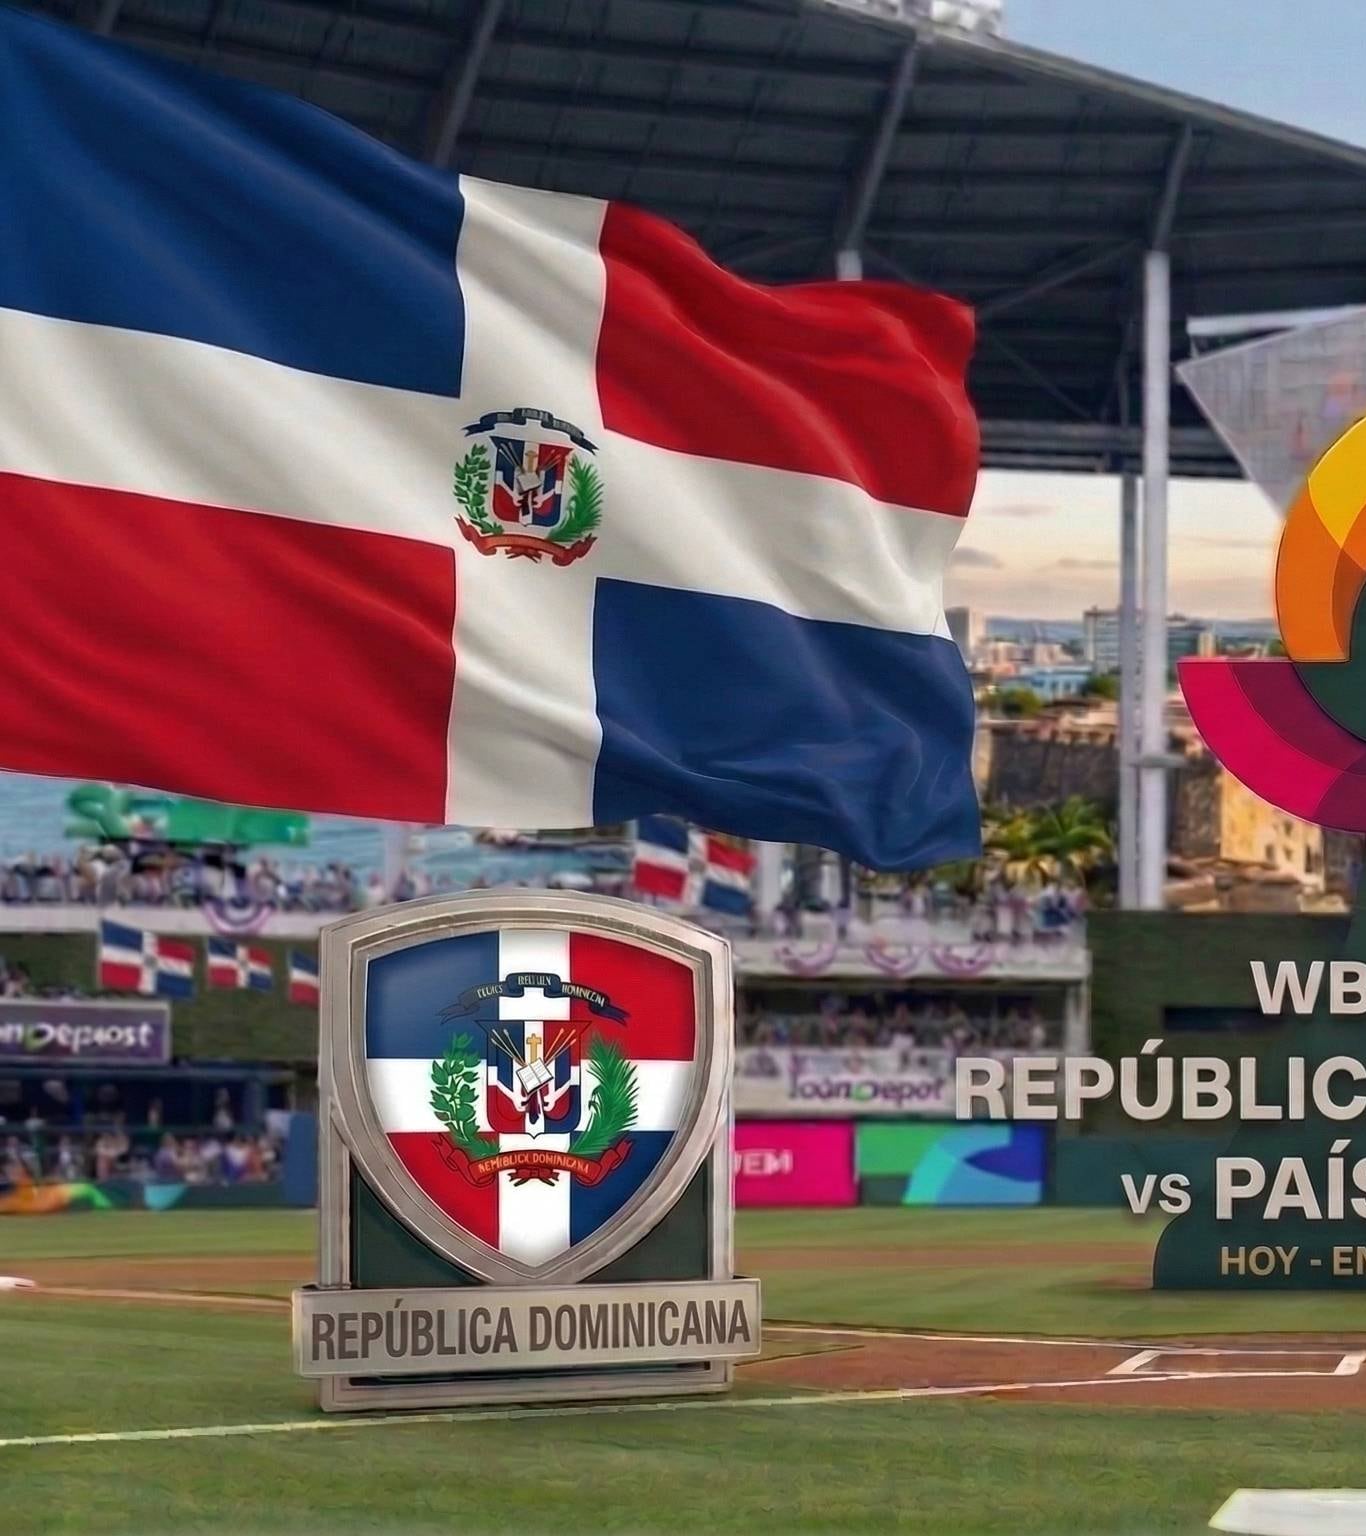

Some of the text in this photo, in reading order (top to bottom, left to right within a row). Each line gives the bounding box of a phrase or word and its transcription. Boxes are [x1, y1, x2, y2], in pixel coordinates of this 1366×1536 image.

[1221, 1246, 1299, 1275] HOY
[311, 1298, 752, 1361] REPÚBLICA DOMINICANA
